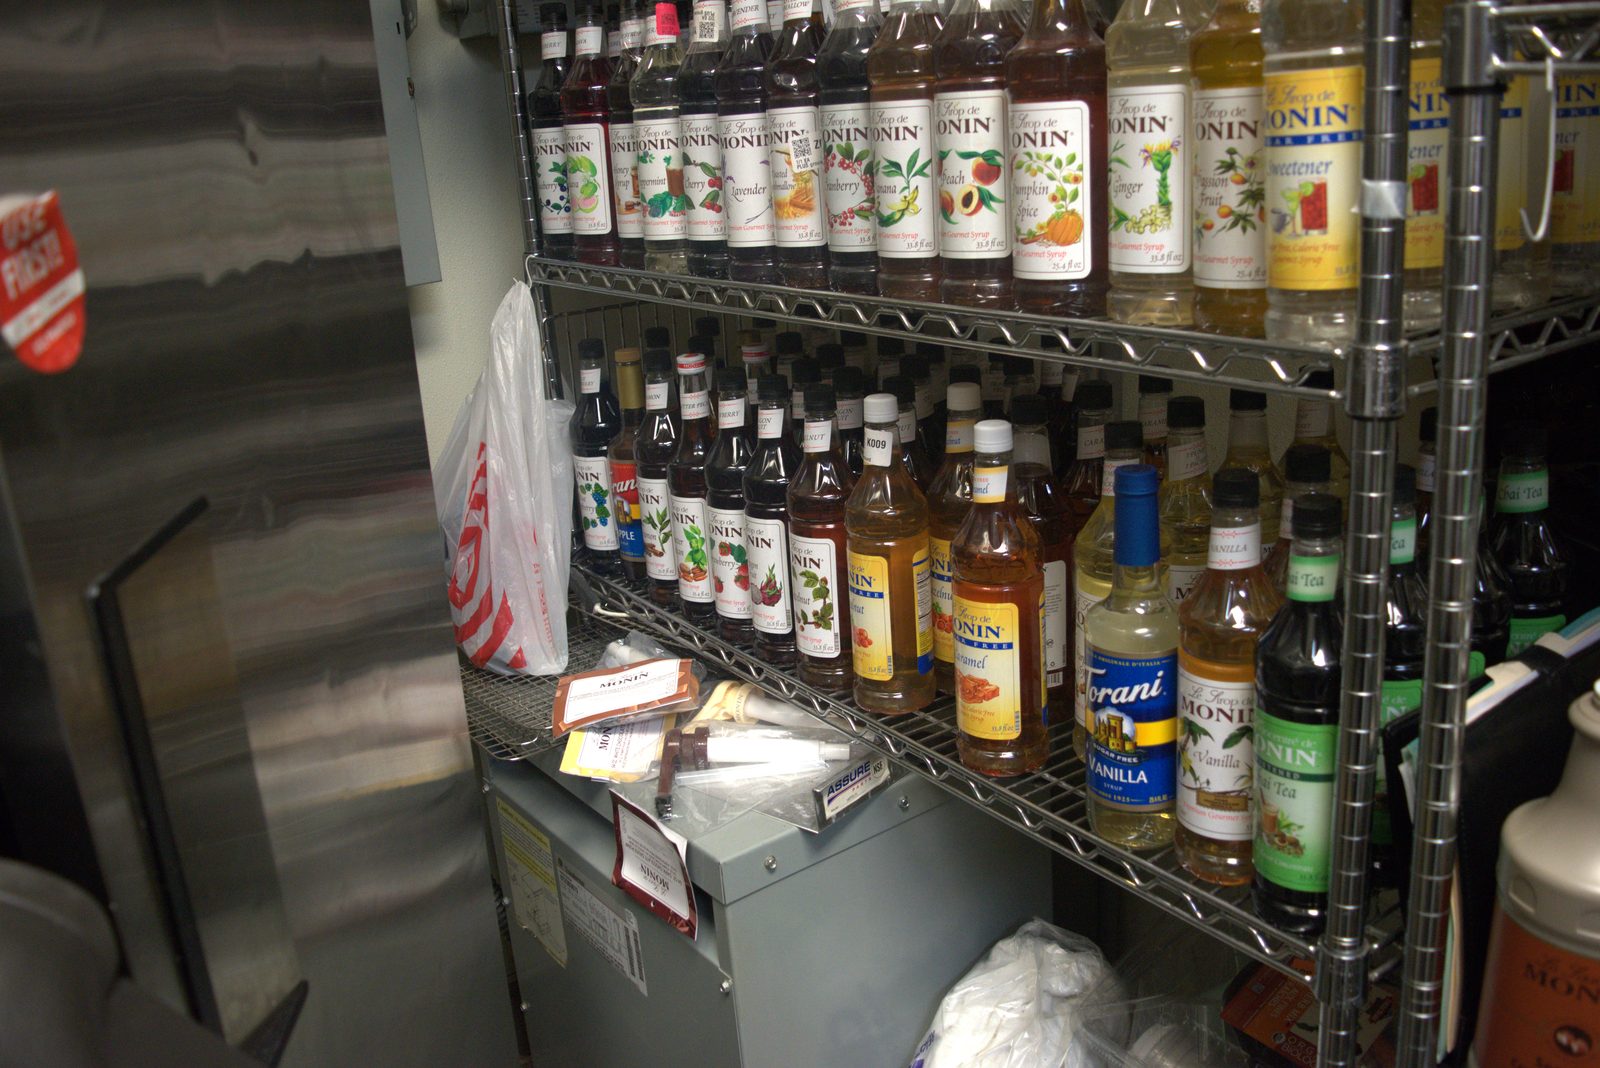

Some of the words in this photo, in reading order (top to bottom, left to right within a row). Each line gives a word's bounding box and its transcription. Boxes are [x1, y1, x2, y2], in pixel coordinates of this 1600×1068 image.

[967, 105, 980, 115] de
[1142, 103, 1156, 113] de
[1230, 107, 1247, 117] de
[847, 117, 859, 126] de
[899, 115, 908, 123] de
[1044, 118, 1058, 128] de
[731, 183, 767, 202] Lavender
[1143, 242, 1164, 253] Syrup
[1046, 250, 1067, 261] Syrup
[867, 438, 886, 450] K009
[577, 471, 600, 482] NIN
[1522, 486, 1544, 499] Tea
[1300, 572, 1325, 587] Tea
[979, 615, 991, 623] de
[973, 640, 1009, 650] FREE
[599, 672, 648, 689] MONIN
[1086, 664, 1164, 706] Torani
[1116, 754, 1139, 764] FREE
[1193, 750, 1240, 769] Vanilla
[873, 760, 883, 774] NSF
[1089, 753, 1148, 784] VANILLA
[827, 761, 871, 798] ASSURE
[1103, 782, 1123, 791] SYRUP
[1274, 781, 1297, 799] Tea
[640, 863, 670, 892] MONIN
